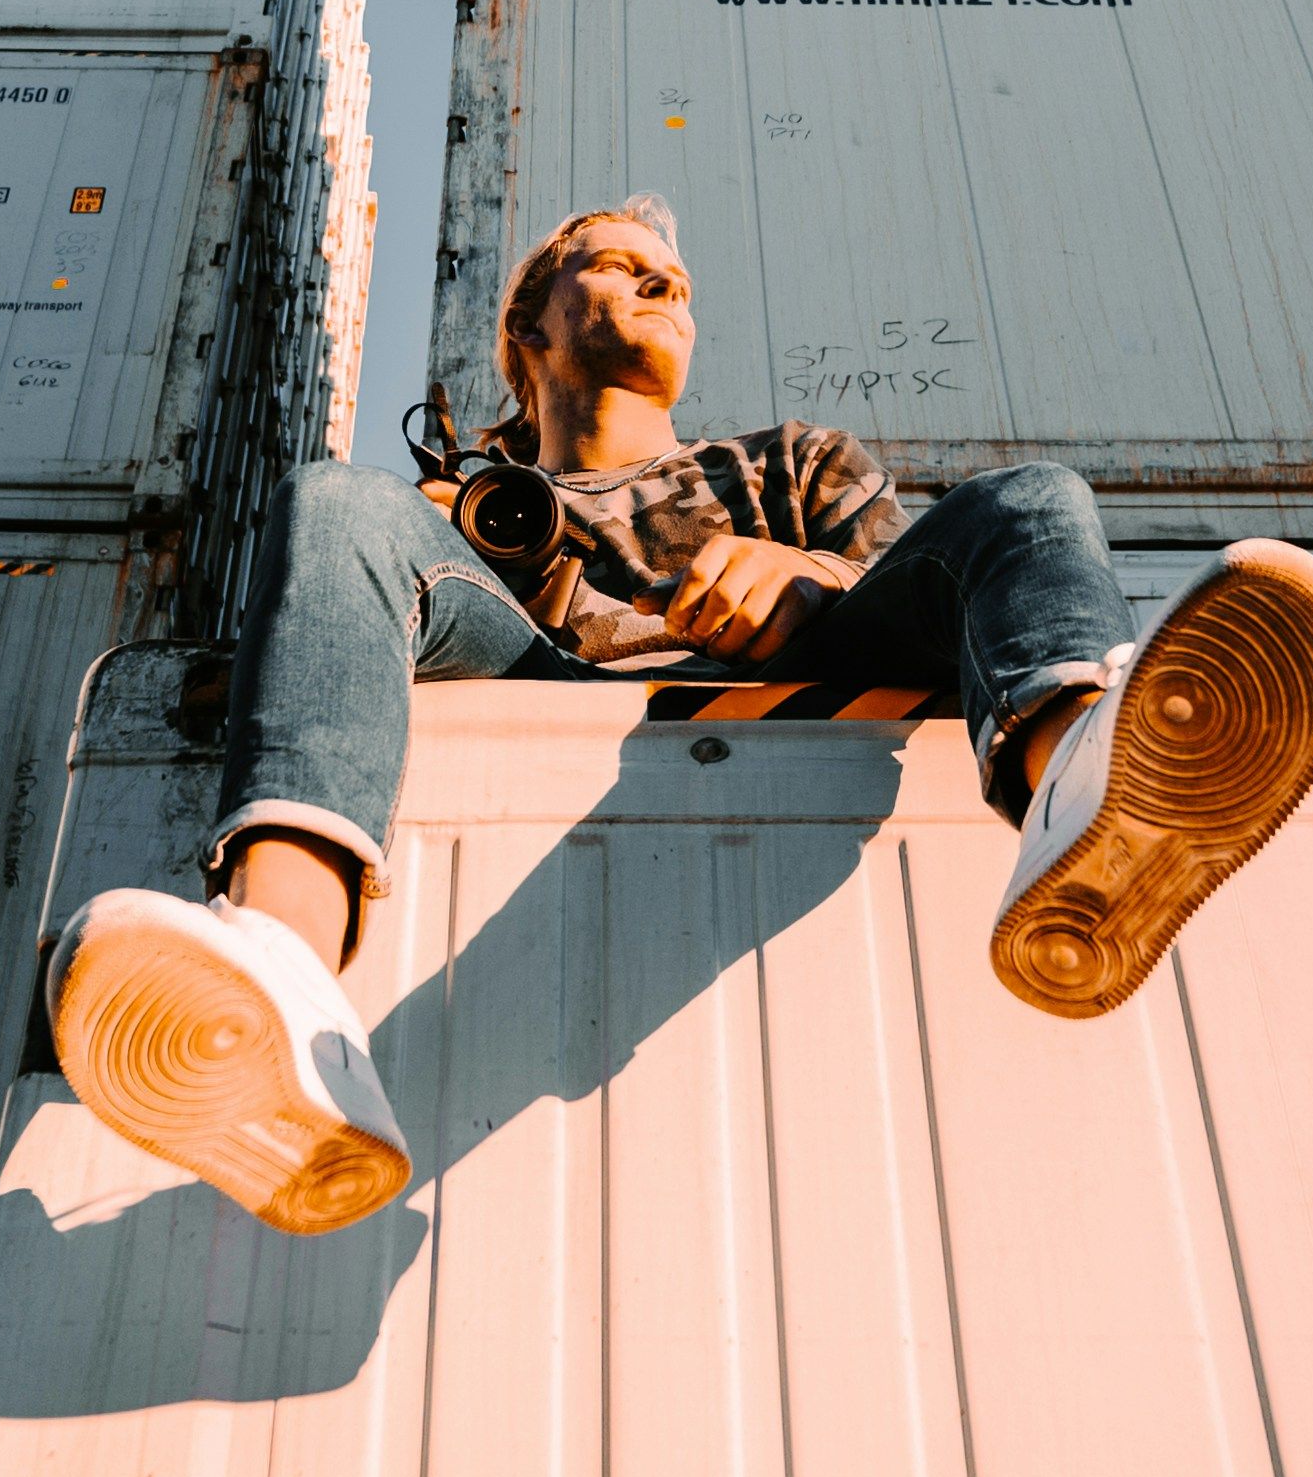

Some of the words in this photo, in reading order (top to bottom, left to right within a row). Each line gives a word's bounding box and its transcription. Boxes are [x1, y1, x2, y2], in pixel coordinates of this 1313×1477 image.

[54, 87, 71, 103] 0
[764, 113, 802, 125] NO
[24, 301, 83, 312] transport
